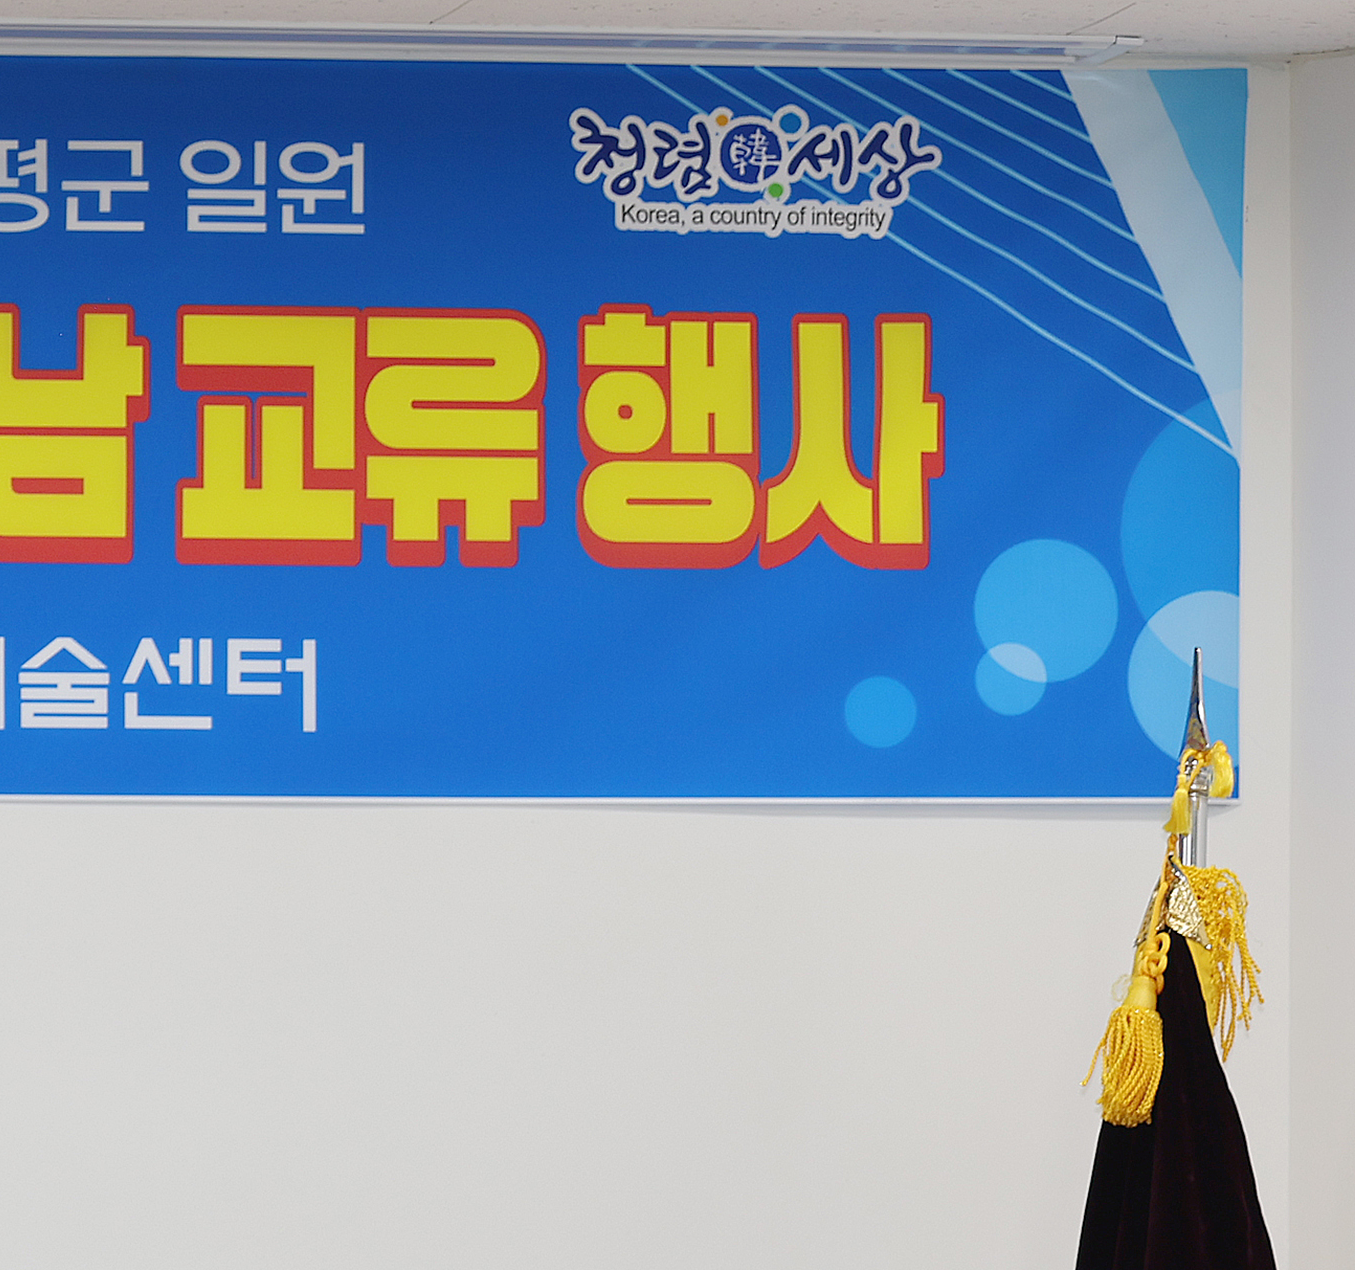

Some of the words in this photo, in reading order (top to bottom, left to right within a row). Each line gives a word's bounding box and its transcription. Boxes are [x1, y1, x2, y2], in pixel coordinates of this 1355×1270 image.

[185, 140, 367, 236] 일원
[621, 204, 685, 226] Korea,
[692, 209, 703, 224] a
[710, 208, 781, 229] country
[788, 206, 806, 225] of
[811, 207, 886, 231] integrity
[181, 311, 541, 543] 교류
[582, 311, 940, 545] 행사
